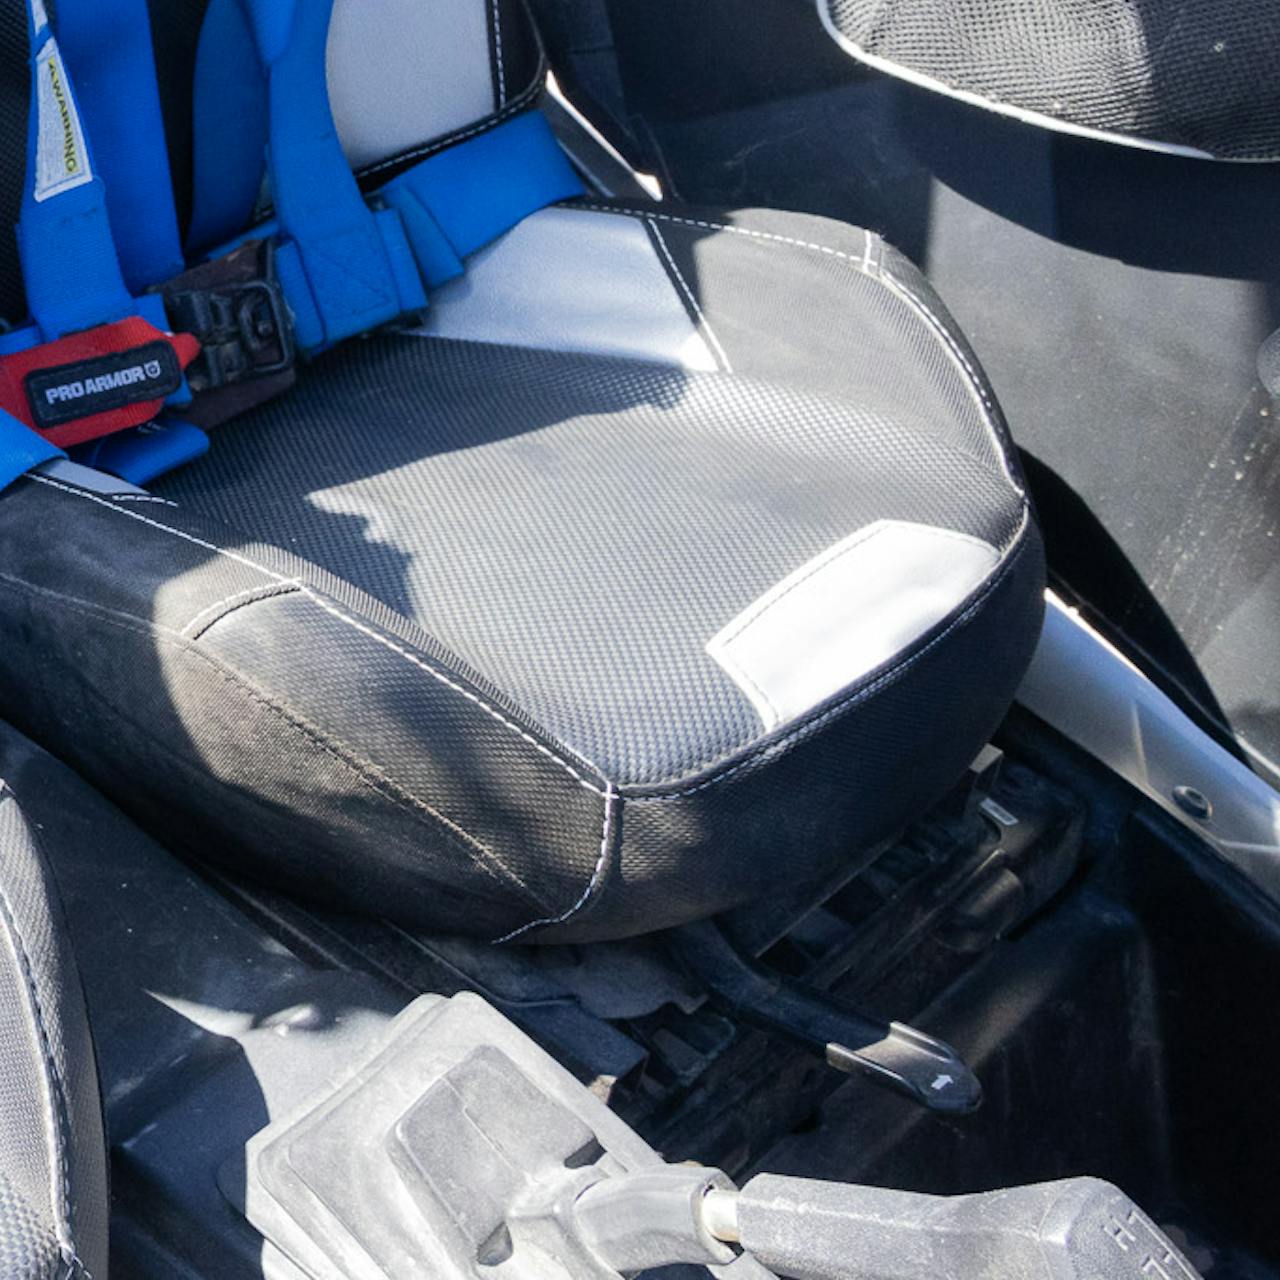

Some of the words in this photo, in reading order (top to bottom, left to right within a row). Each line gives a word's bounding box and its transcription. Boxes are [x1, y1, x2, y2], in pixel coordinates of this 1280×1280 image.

[51, 78, 78, 173] WARNING
[45, 380, 85, 404] PRO
[85, 365, 146, 395] ARMOR
